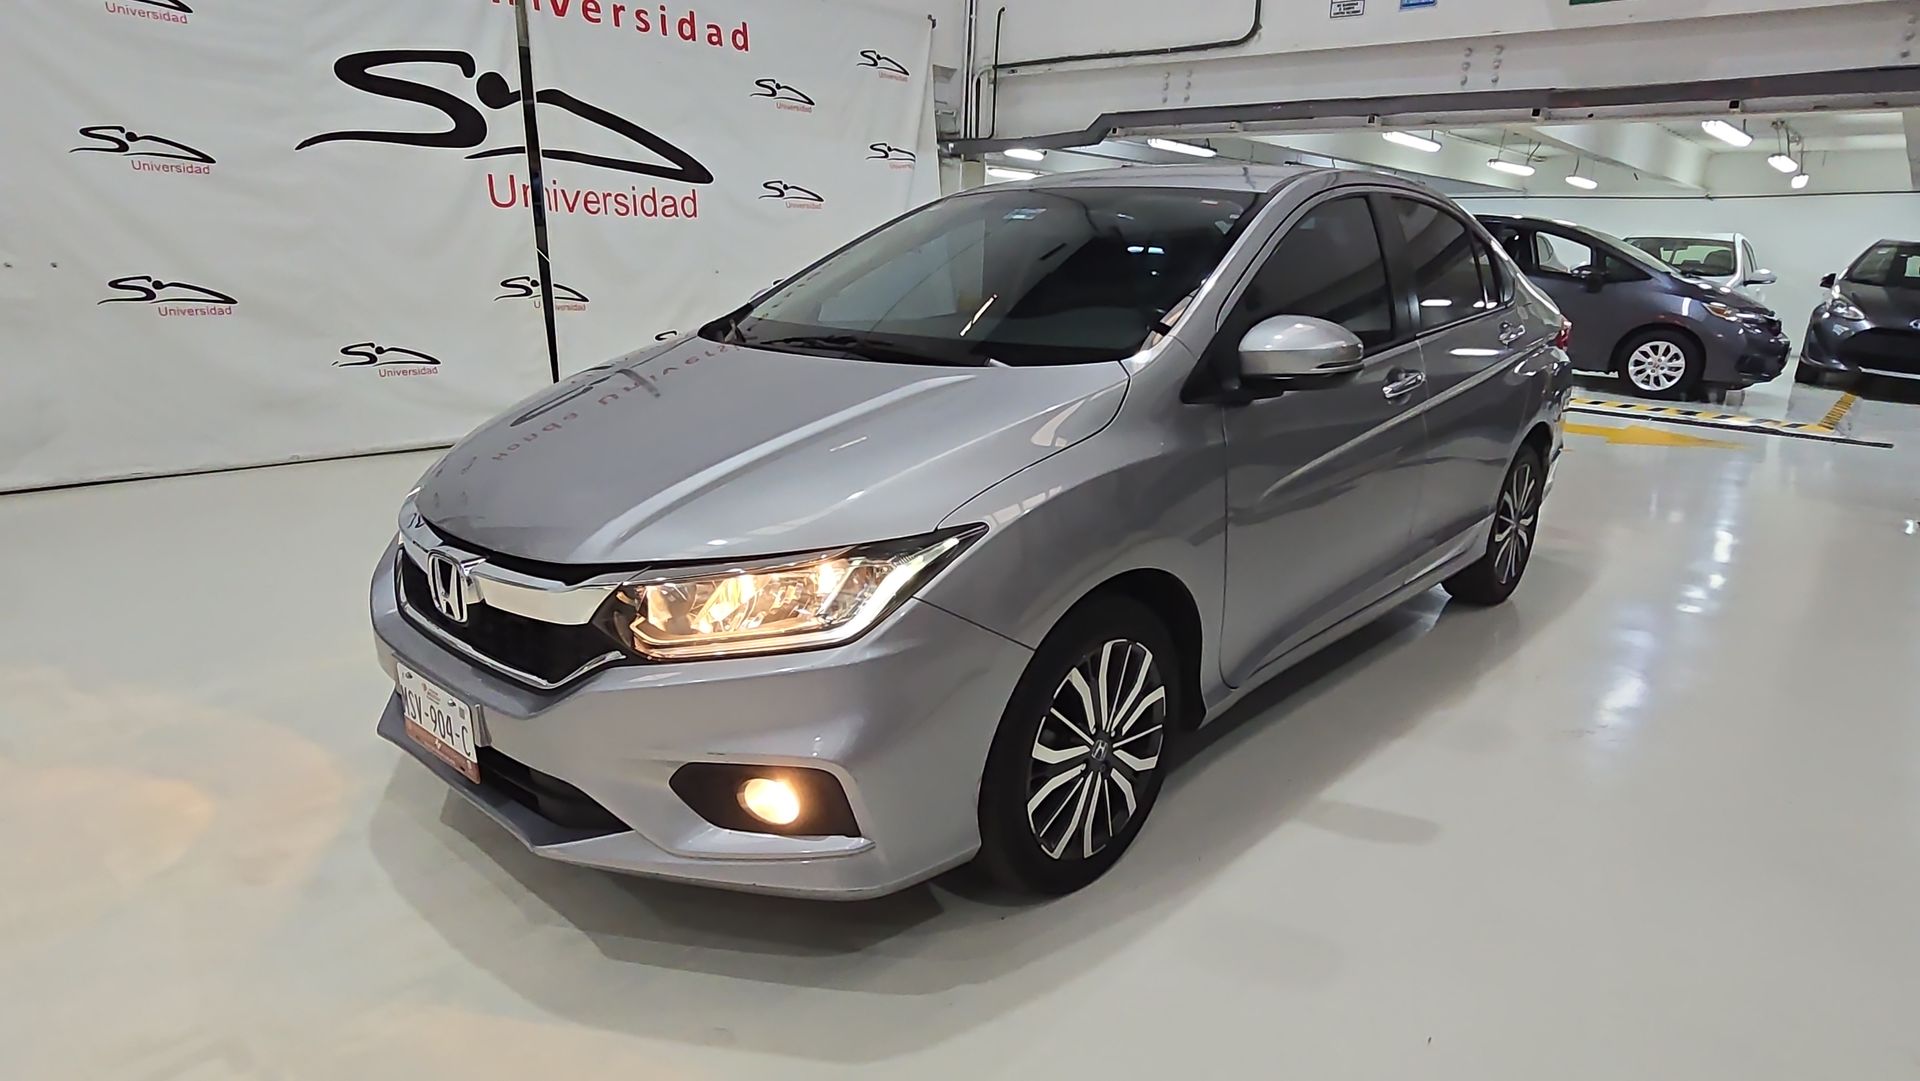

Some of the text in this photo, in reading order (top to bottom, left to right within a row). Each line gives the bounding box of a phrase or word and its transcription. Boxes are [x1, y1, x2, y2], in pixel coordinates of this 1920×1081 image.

[105, 1, 188, 24] Universidad
[131, 159, 211, 175] Universidad
[157, 306, 233, 317] Universidad
[378, 366, 439, 379] Universidad
